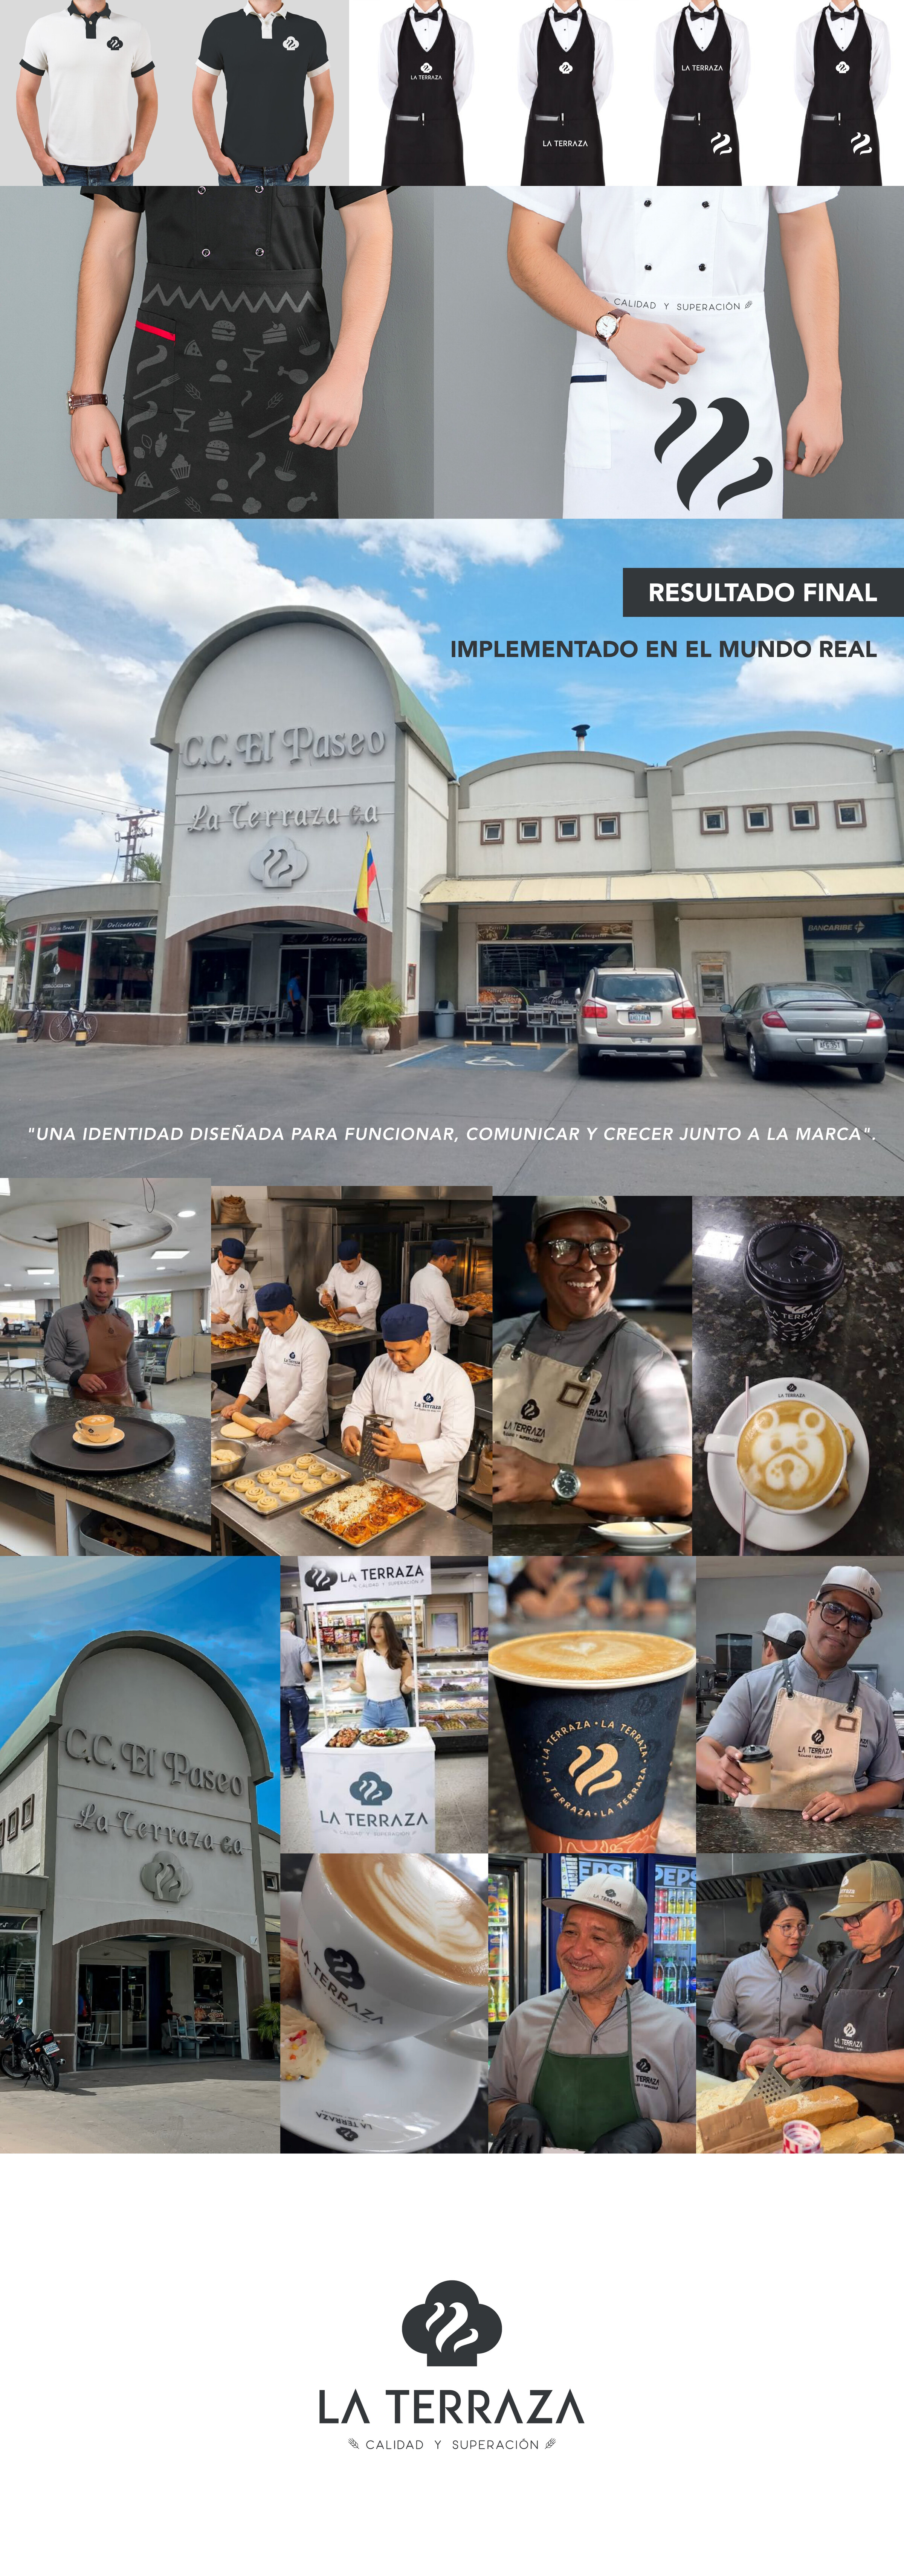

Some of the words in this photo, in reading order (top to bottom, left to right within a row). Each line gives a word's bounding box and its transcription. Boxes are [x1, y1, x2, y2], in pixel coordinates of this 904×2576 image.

[614, 298, 656, 309] CALIDAD
[677, 302, 740, 311] SUPERACIÓN
[182, 734, 231, 767] C.C.
[235, 730, 276, 764] El
[282, 727, 385, 764] Paseo
[187, 804, 220, 832] La
[228, 801, 339, 828] Terraza
[767, 1306, 778, 1316] LA
[781, 1305, 823, 1319] TERRAZA
[587, 1408, 607, 1418] RRAZA
[504, 1421, 512, 1429] LA
[514, 1422, 545, 1438] TERRAZA
[341, 1571, 357, 1582] LA
[360, 1565, 424, 1580] TERRAZA
[546, 1720, 591, 1746] TERRAZA
[601, 1720, 614, 1728] LA
[619, 1723, 648, 1758] TERRAZA
[65, 1728, 118, 1770] C.C.
[121, 1742, 157, 1777] El
[163, 1751, 244, 1796] Paseo
[543, 1748, 550, 1760] LA
[600, 1808, 614, 1817] LA
[616, 1768, 647, 1809] TERRAZA
[550, 1786, 591, 1817] TERRAZA
[320, 1810, 340, 1825] LA
[345, 1812, 428, 1827] TERRAZA
[75, 1803, 108, 1834] La
[118, 1810, 215, 1852] Terraza
[601, 1896, 622, 1908] TERRAZA
[301, 1938, 309, 1964] LA
[314, 1962, 383, 2024] TERRAZA
[329, 1997, 362, 2021] SUPERACIÓN
[841, 2039, 863, 2048] TERRAZA
[636, 2075, 659, 2086] TERRAZA
[316, 2111, 359, 2128] TERRAZA
